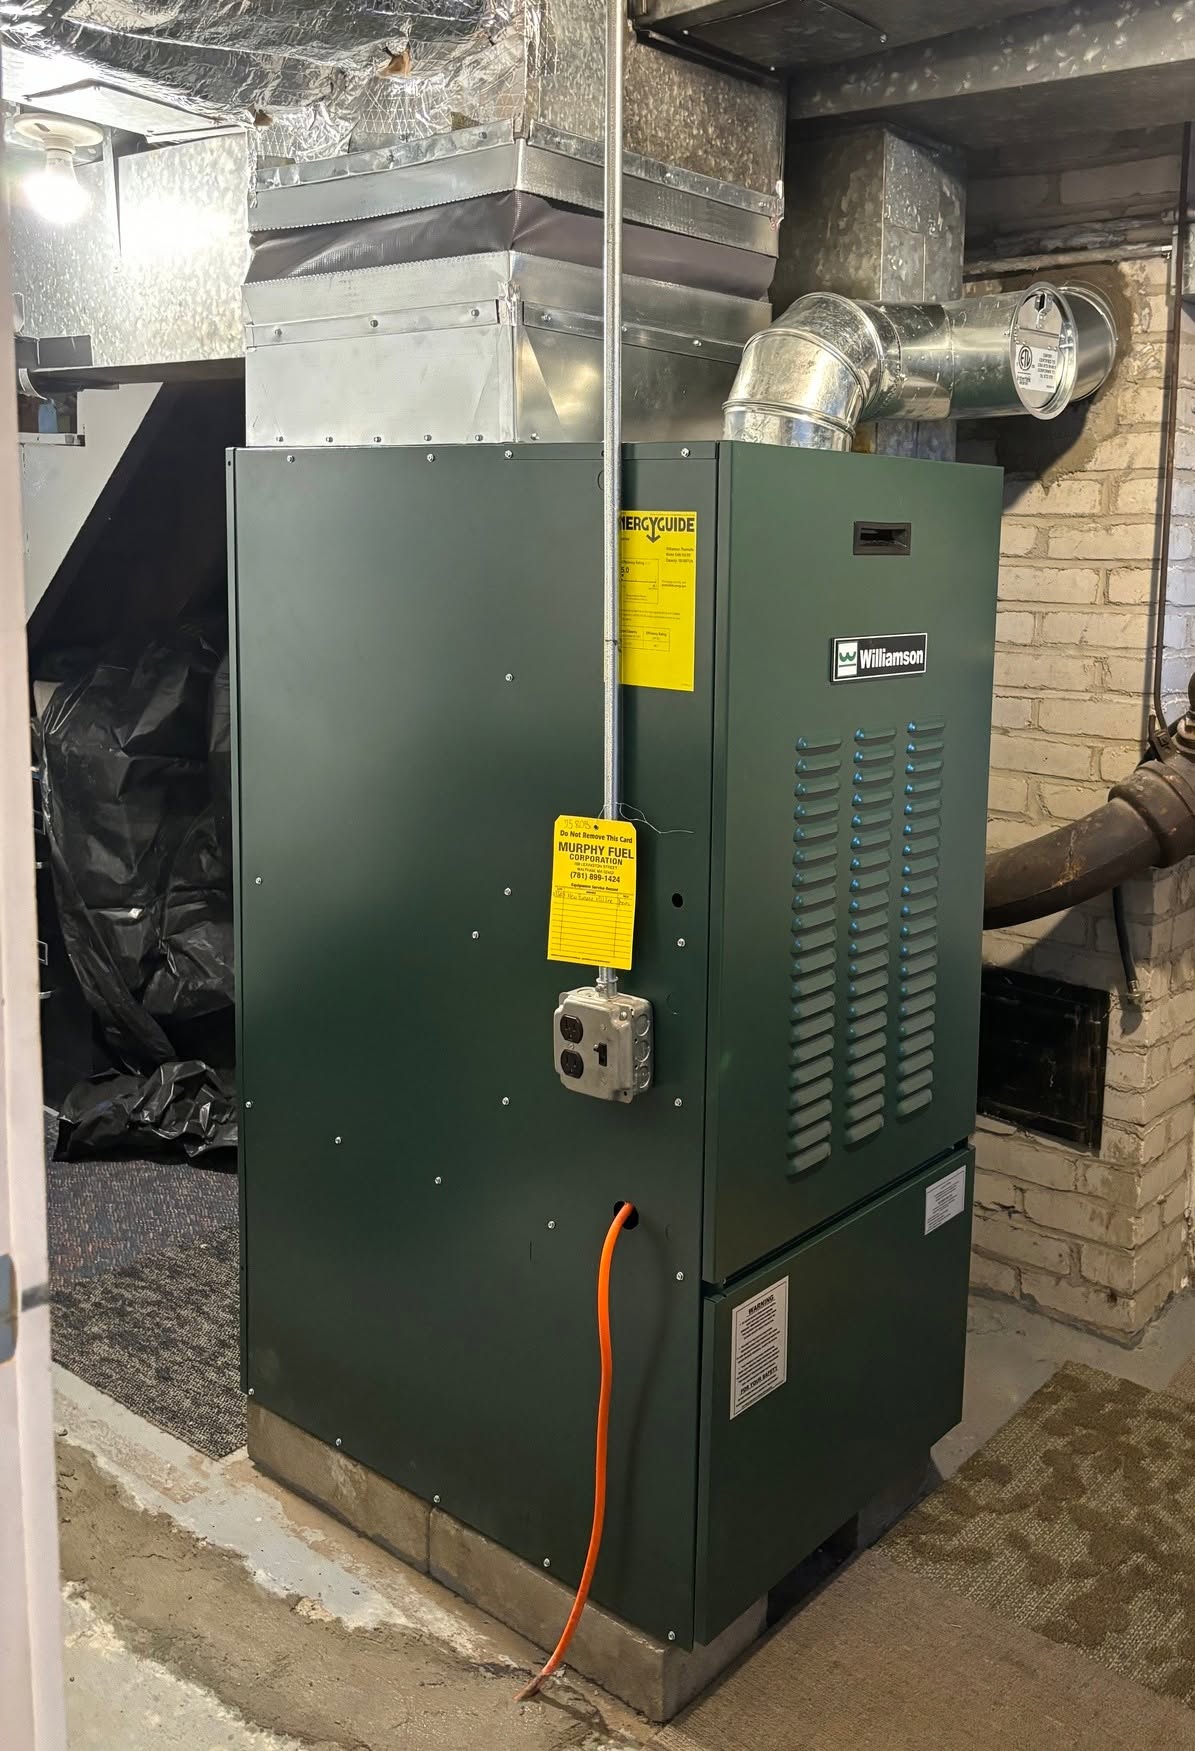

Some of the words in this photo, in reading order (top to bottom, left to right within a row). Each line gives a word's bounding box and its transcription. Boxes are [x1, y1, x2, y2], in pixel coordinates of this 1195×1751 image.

[620, 516, 695, 532] NERGYGUIDE
[859, 648, 924, 669] Williamson
[560, 829, 569, 837] Do
[582, 832, 605, 841] Remove
[606, 834, 619, 842] This
[619, 836, 633, 844] Card
[558, 841, 605, 856] MURPHY
[608, 846, 635, 860] FUEL
[569, 853, 623, 866] CORPORATION
[570, 871, 588, 880] (781)
[589, 873, 621, 883] 899-1424
[749, 1294, 775, 1315] WARNING
